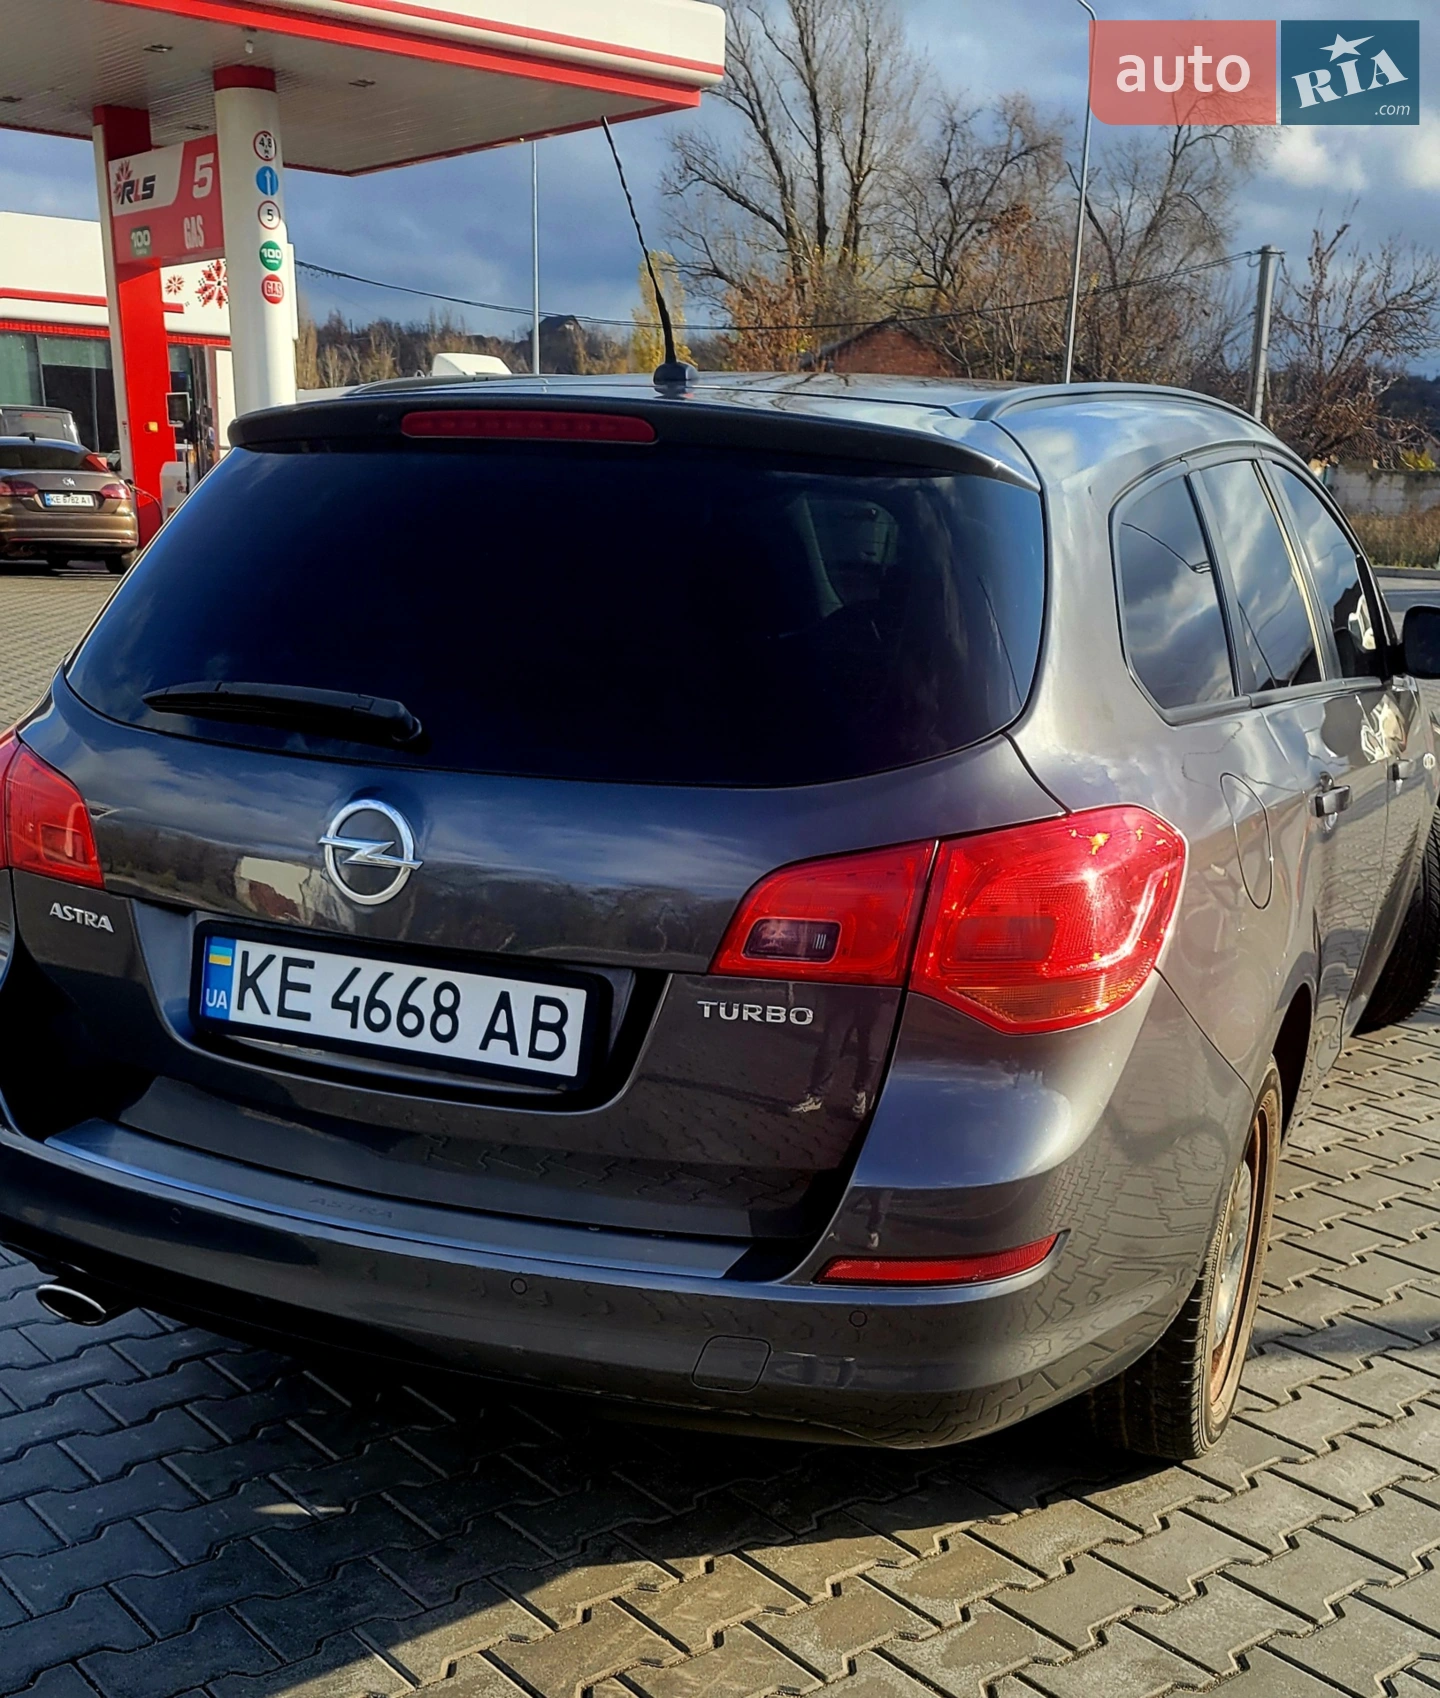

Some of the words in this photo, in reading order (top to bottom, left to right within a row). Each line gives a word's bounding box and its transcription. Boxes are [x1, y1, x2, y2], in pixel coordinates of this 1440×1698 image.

[192, 152, 215, 199] 5
[120, 174, 156, 205] RLS
[266, 208, 274, 222] 5
[130, 229, 151, 248] 100
[183, 214, 205, 250] GAS
[261, 248, 282, 260] 100
[266, 281, 281, 296] GAS
[49, 902, 114, 933] ASTRA
[205, 987, 228, 1011] UA
[236, 950, 315, 1022] KE
[331, 966, 461, 1044] 4668
[478, 990, 569, 1062] AB
[697, 1000, 814, 1025] TURBO
